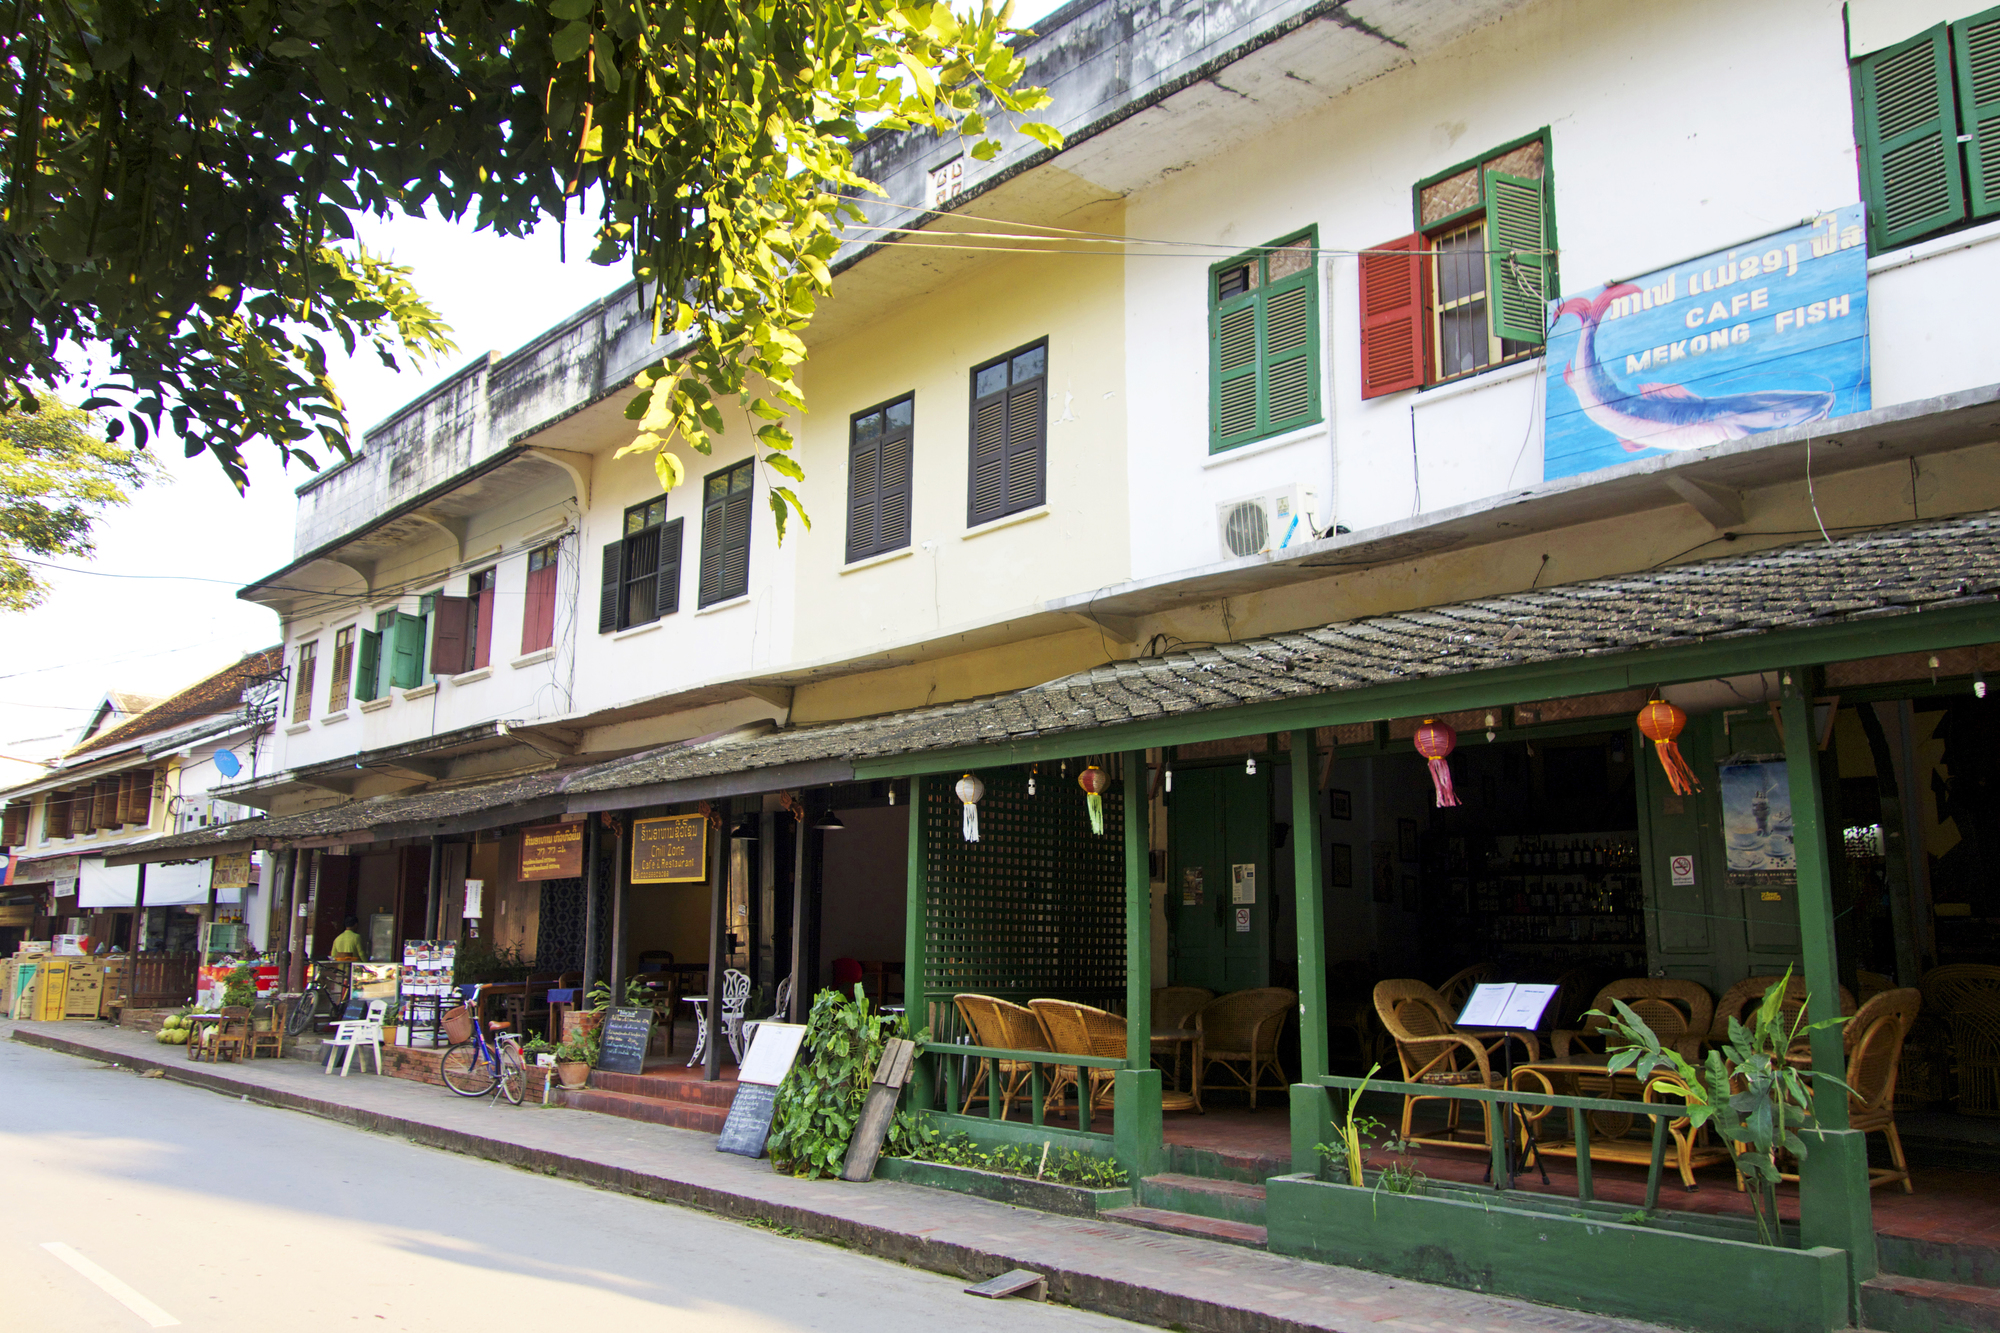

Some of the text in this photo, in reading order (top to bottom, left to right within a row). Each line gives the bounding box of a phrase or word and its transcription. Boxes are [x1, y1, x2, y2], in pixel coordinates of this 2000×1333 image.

[1685, 287, 1769, 329] CAFE
[1626, 293, 1850, 375] MEKONG FISH
[651, 843, 685, 858] Chill Zone
[661, 858, 694, 869] Restaurant
